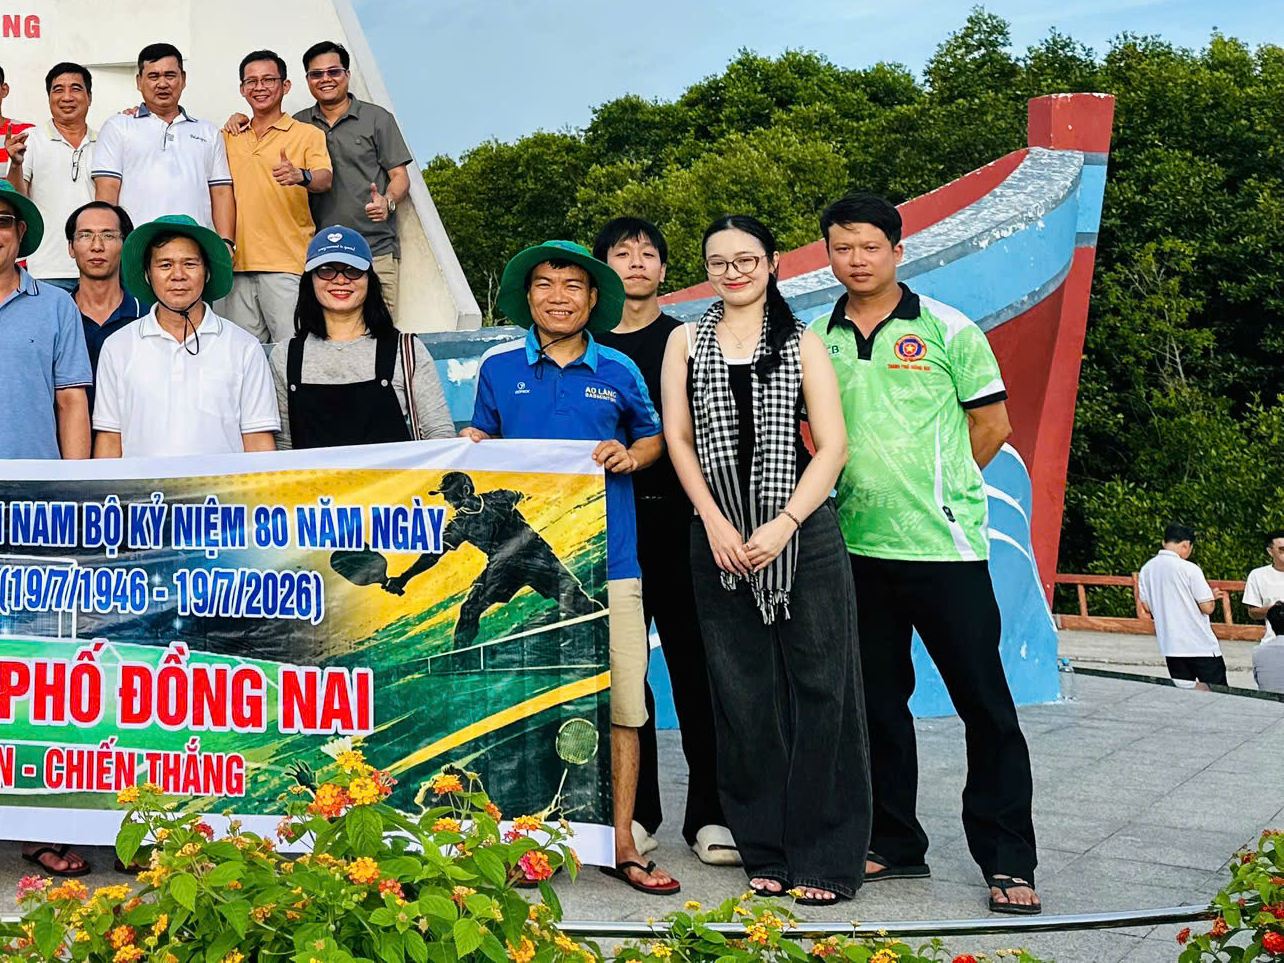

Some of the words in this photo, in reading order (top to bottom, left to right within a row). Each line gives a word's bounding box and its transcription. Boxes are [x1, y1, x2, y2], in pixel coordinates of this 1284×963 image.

[12, 503, 75, 545] NAM
[85, 497, 121, 555] BỘ
[130, 494, 166, 548] KỶ
[173, 497, 246, 557] NIỆM
[254, 506, 288, 548] 80
[296, 498, 363, 549] NĂM
[371, 499, 445, 551] NGÀY
[0, 568, 148, 614] (19/7/1946
[176, 569, 324, 622] 19/7/2026)
[119, 645, 264, 729] ĐỒNG
[282, 671, 371, 731] NAI
[45, 737, 137, 790] CHIẾN
[145, 737, 245, 796] THẮNG
